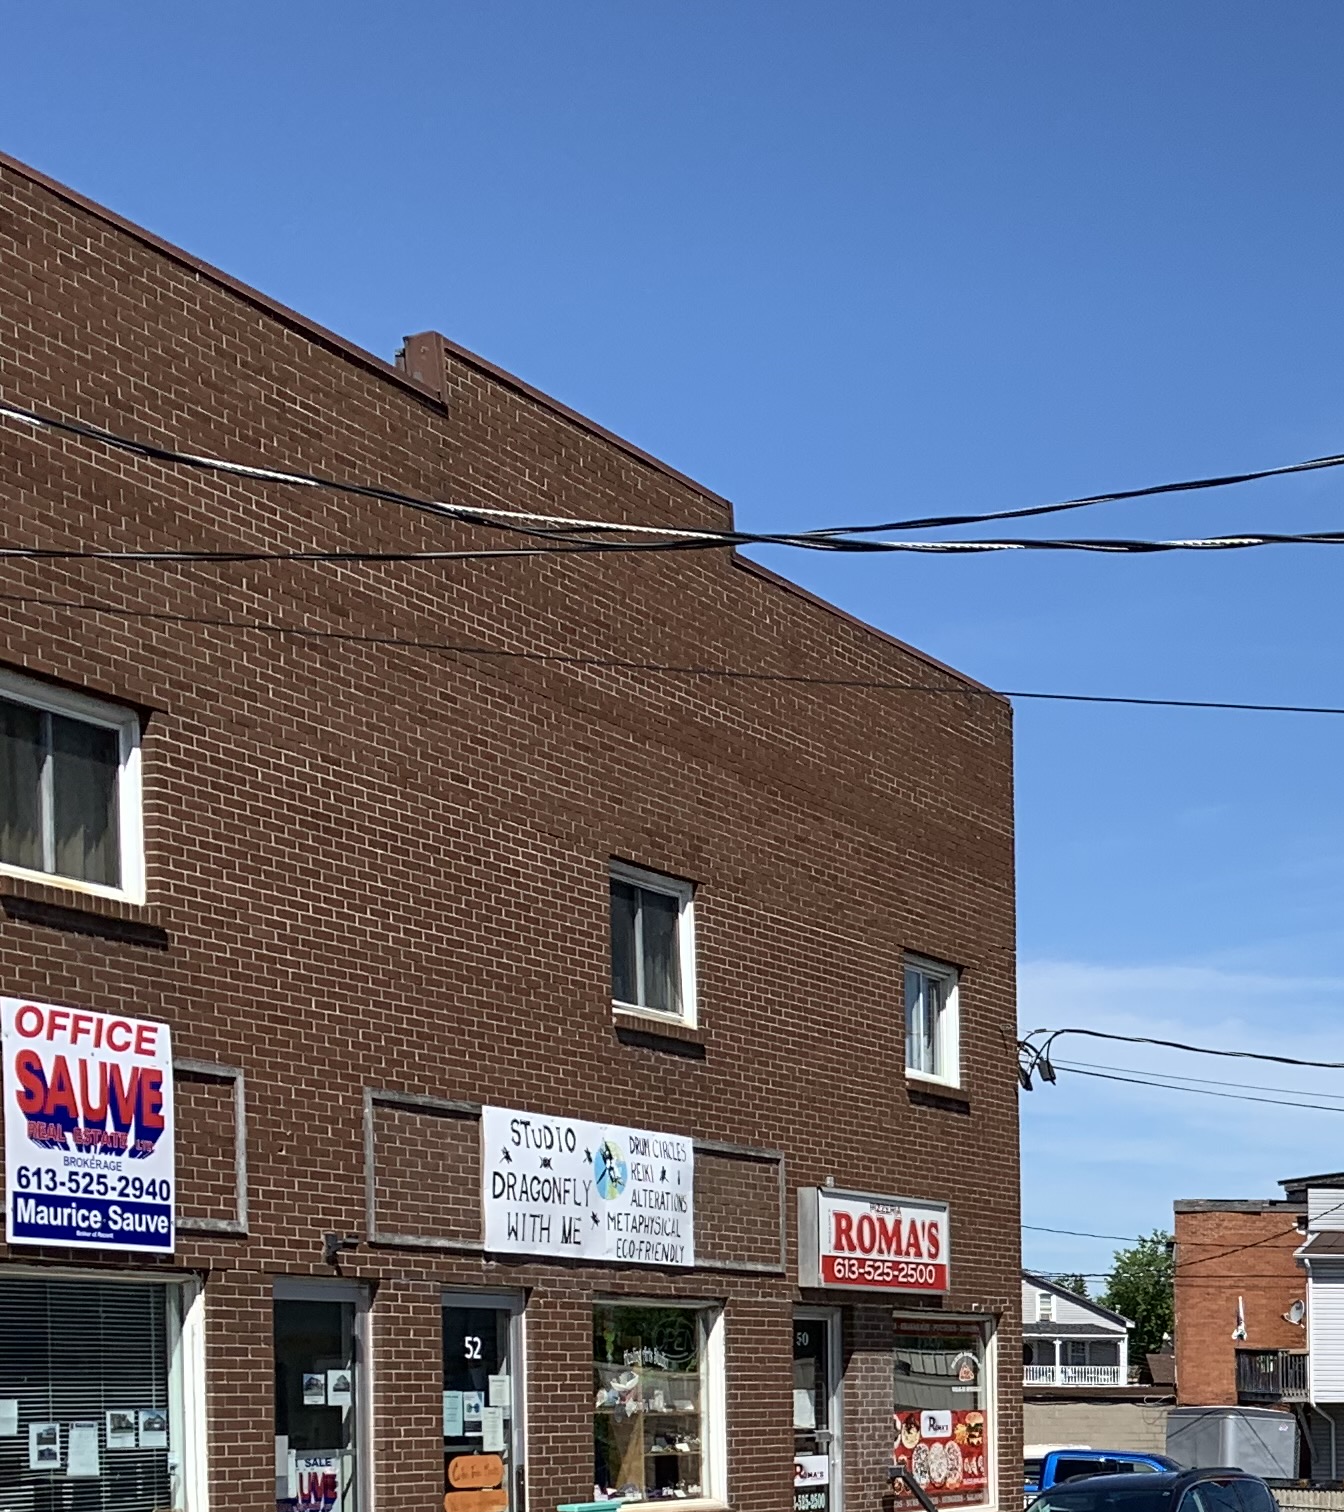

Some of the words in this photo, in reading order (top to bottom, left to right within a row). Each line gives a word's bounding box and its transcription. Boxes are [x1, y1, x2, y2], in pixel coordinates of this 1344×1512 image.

[15, 1005, 159, 1056] OFFICE
[15, 1049, 165, 1131] SAUVE
[27, 1120, 66, 1142] REAL
[73, 1127, 129, 1150] ESTATE
[510, 1118, 577, 1153] STUDIO
[628, 1136, 650, 1158] DRUM
[653, 1140, 688, 1162] CIRCLES
[63, 1156, 122, 1171] BROKERAGE
[631, 1163, 654, 1183] REIKI
[17, 1166, 171, 1201] 613-525-2940
[492, 1171, 592, 1207] DRAGONFLY
[630, 1189, 688, 1214] ALTERATIONS
[16, 1198, 102, 1229] Maurice
[108, 1205, 169, 1234] Sauve
[507, 1212, 551, 1243] WITH
[560, 1216, 582, 1245] ME
[607, 1212, 681, 1238] METAPHYSICAL
[832, 1210, 940, 1261] ROMA'S
[616, 1238, 685, 1263] ECO-FRIENDLY
[833, 1258, 936, 1284] 613-525-2500
[464, 1336, 482, 1359] 52
[796, 1331, 809, 1347] 50
[305, 1458, 332, 1468] SALE
[297, 1472, 338, 1501] UVE
